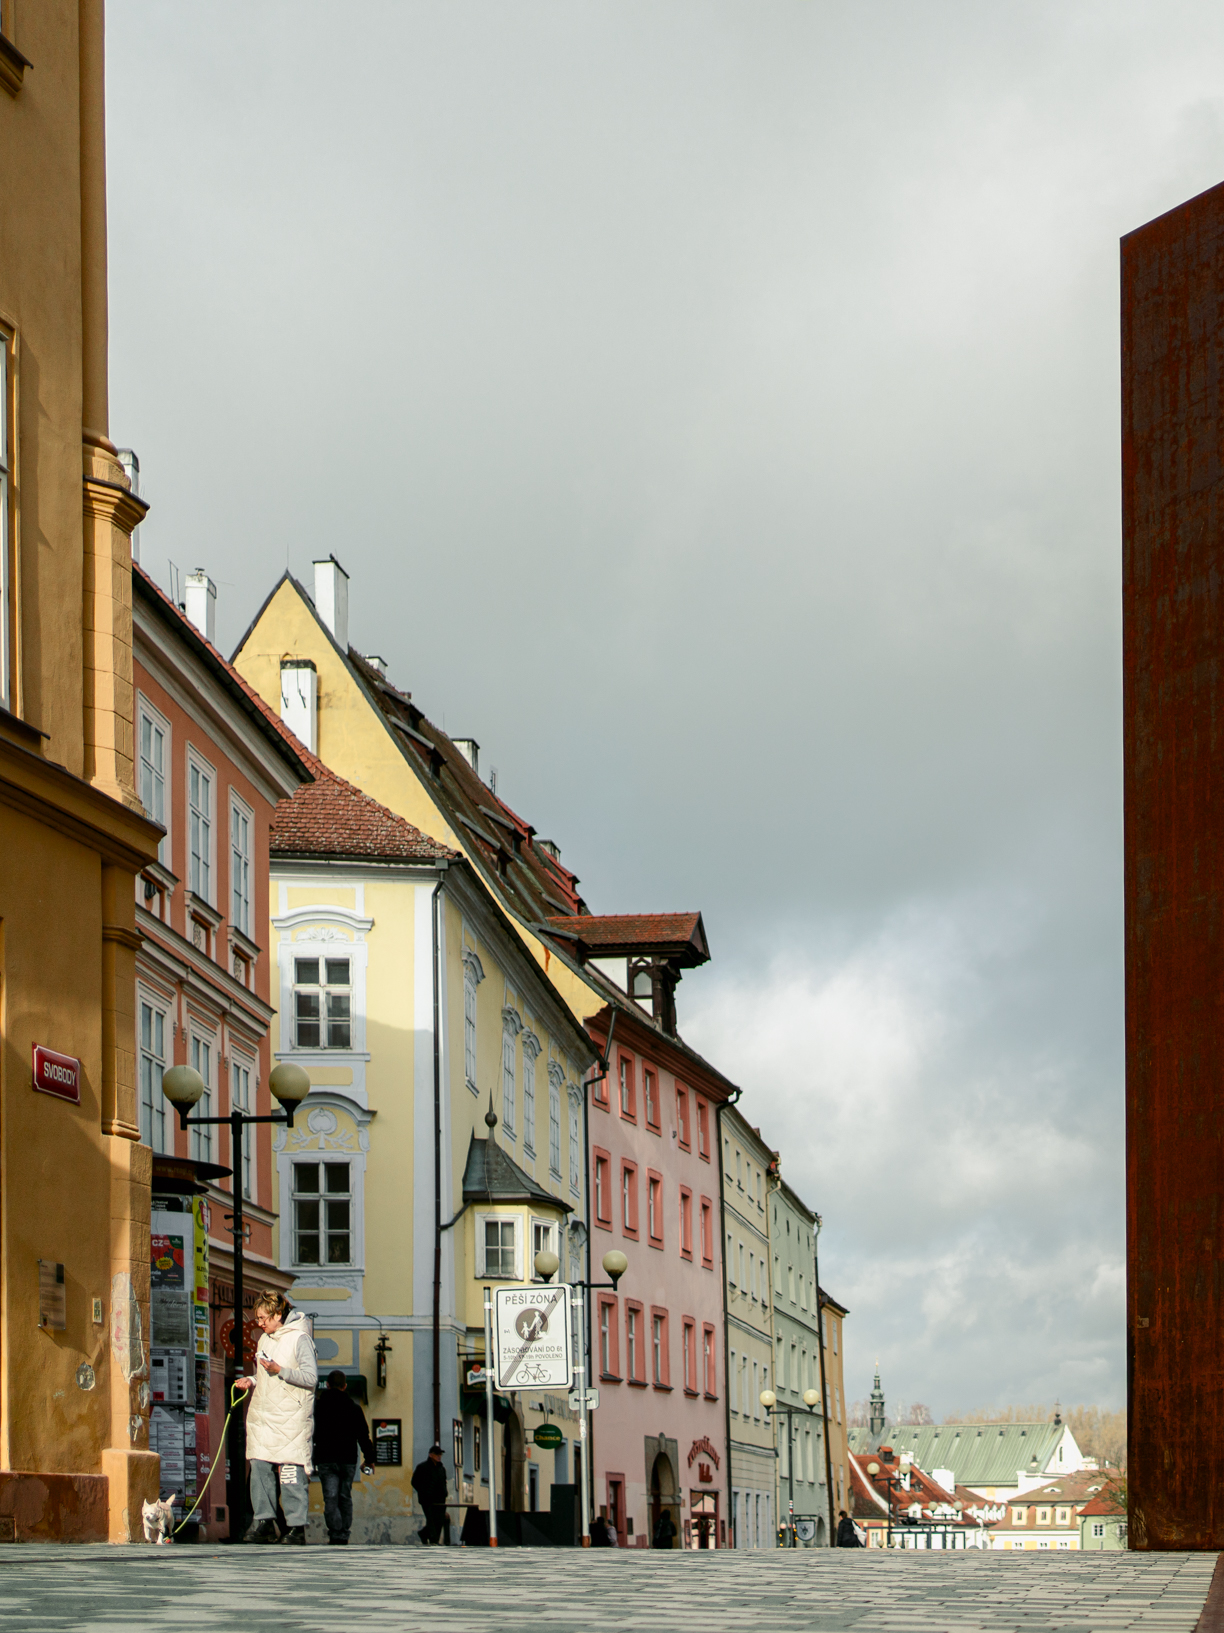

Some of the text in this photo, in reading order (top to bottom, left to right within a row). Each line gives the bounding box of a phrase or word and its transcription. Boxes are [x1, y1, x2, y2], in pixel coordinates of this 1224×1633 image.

[44, 1061, 77, 1087] SVOBODY
[505, 1292, 558, 1305] PĚŠÍ ZÓNA
[534, 1434, 561, 1442] Chance
